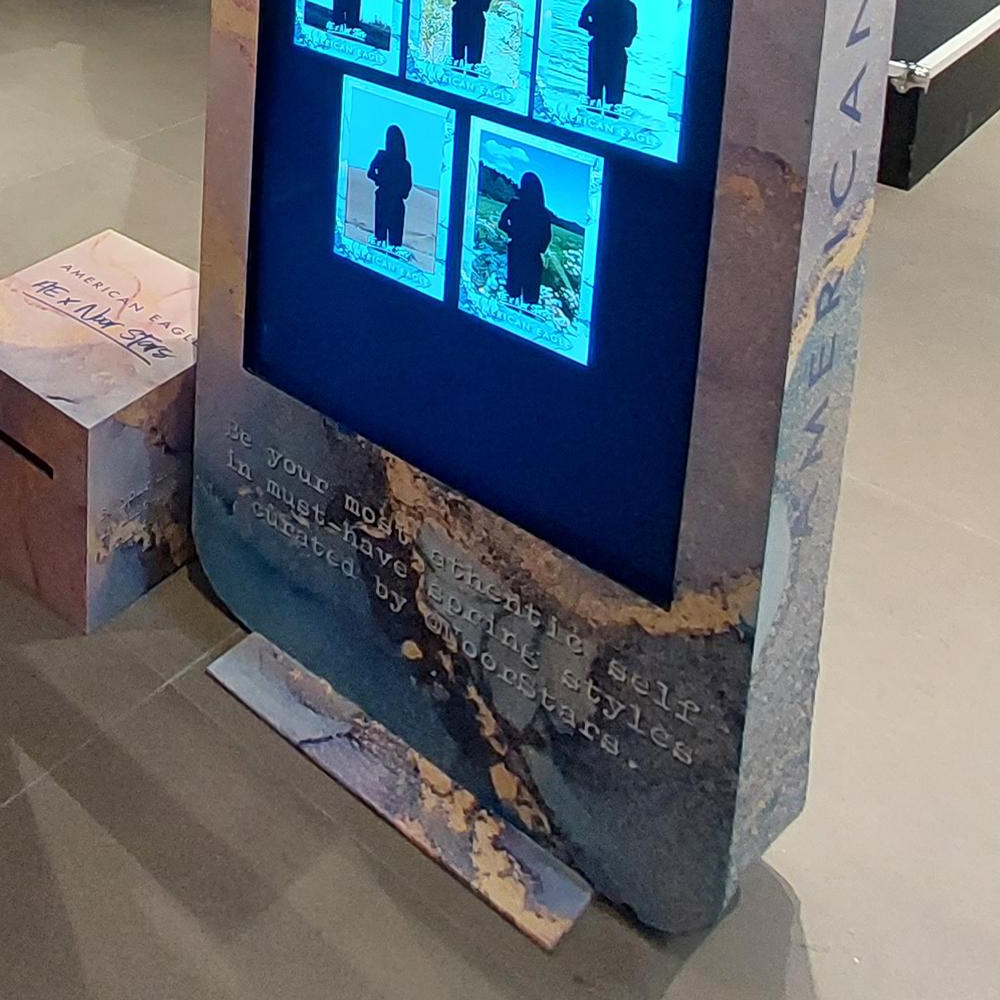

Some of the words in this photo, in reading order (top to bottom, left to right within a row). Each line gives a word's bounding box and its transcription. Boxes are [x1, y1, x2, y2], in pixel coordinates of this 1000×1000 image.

[31, 280, 70, 298] AE
[73, 304, 125, 330] Noor
[119, 328, 176, 359] Stars
[60, 263, 144, 313] AMERICAN
[226, 418, 252, 448] Be
[266, 447, 329, 495] your
[344, 494, 411, 546] most
[226, 449, 253, 482] in
[266, 478, 409, 579] must-have
[427, 582, 541, 671] spring
[561, 668, 694, 766] styles
[252, 500, 360, 581] curated
[374, 574, 408, 614] by
